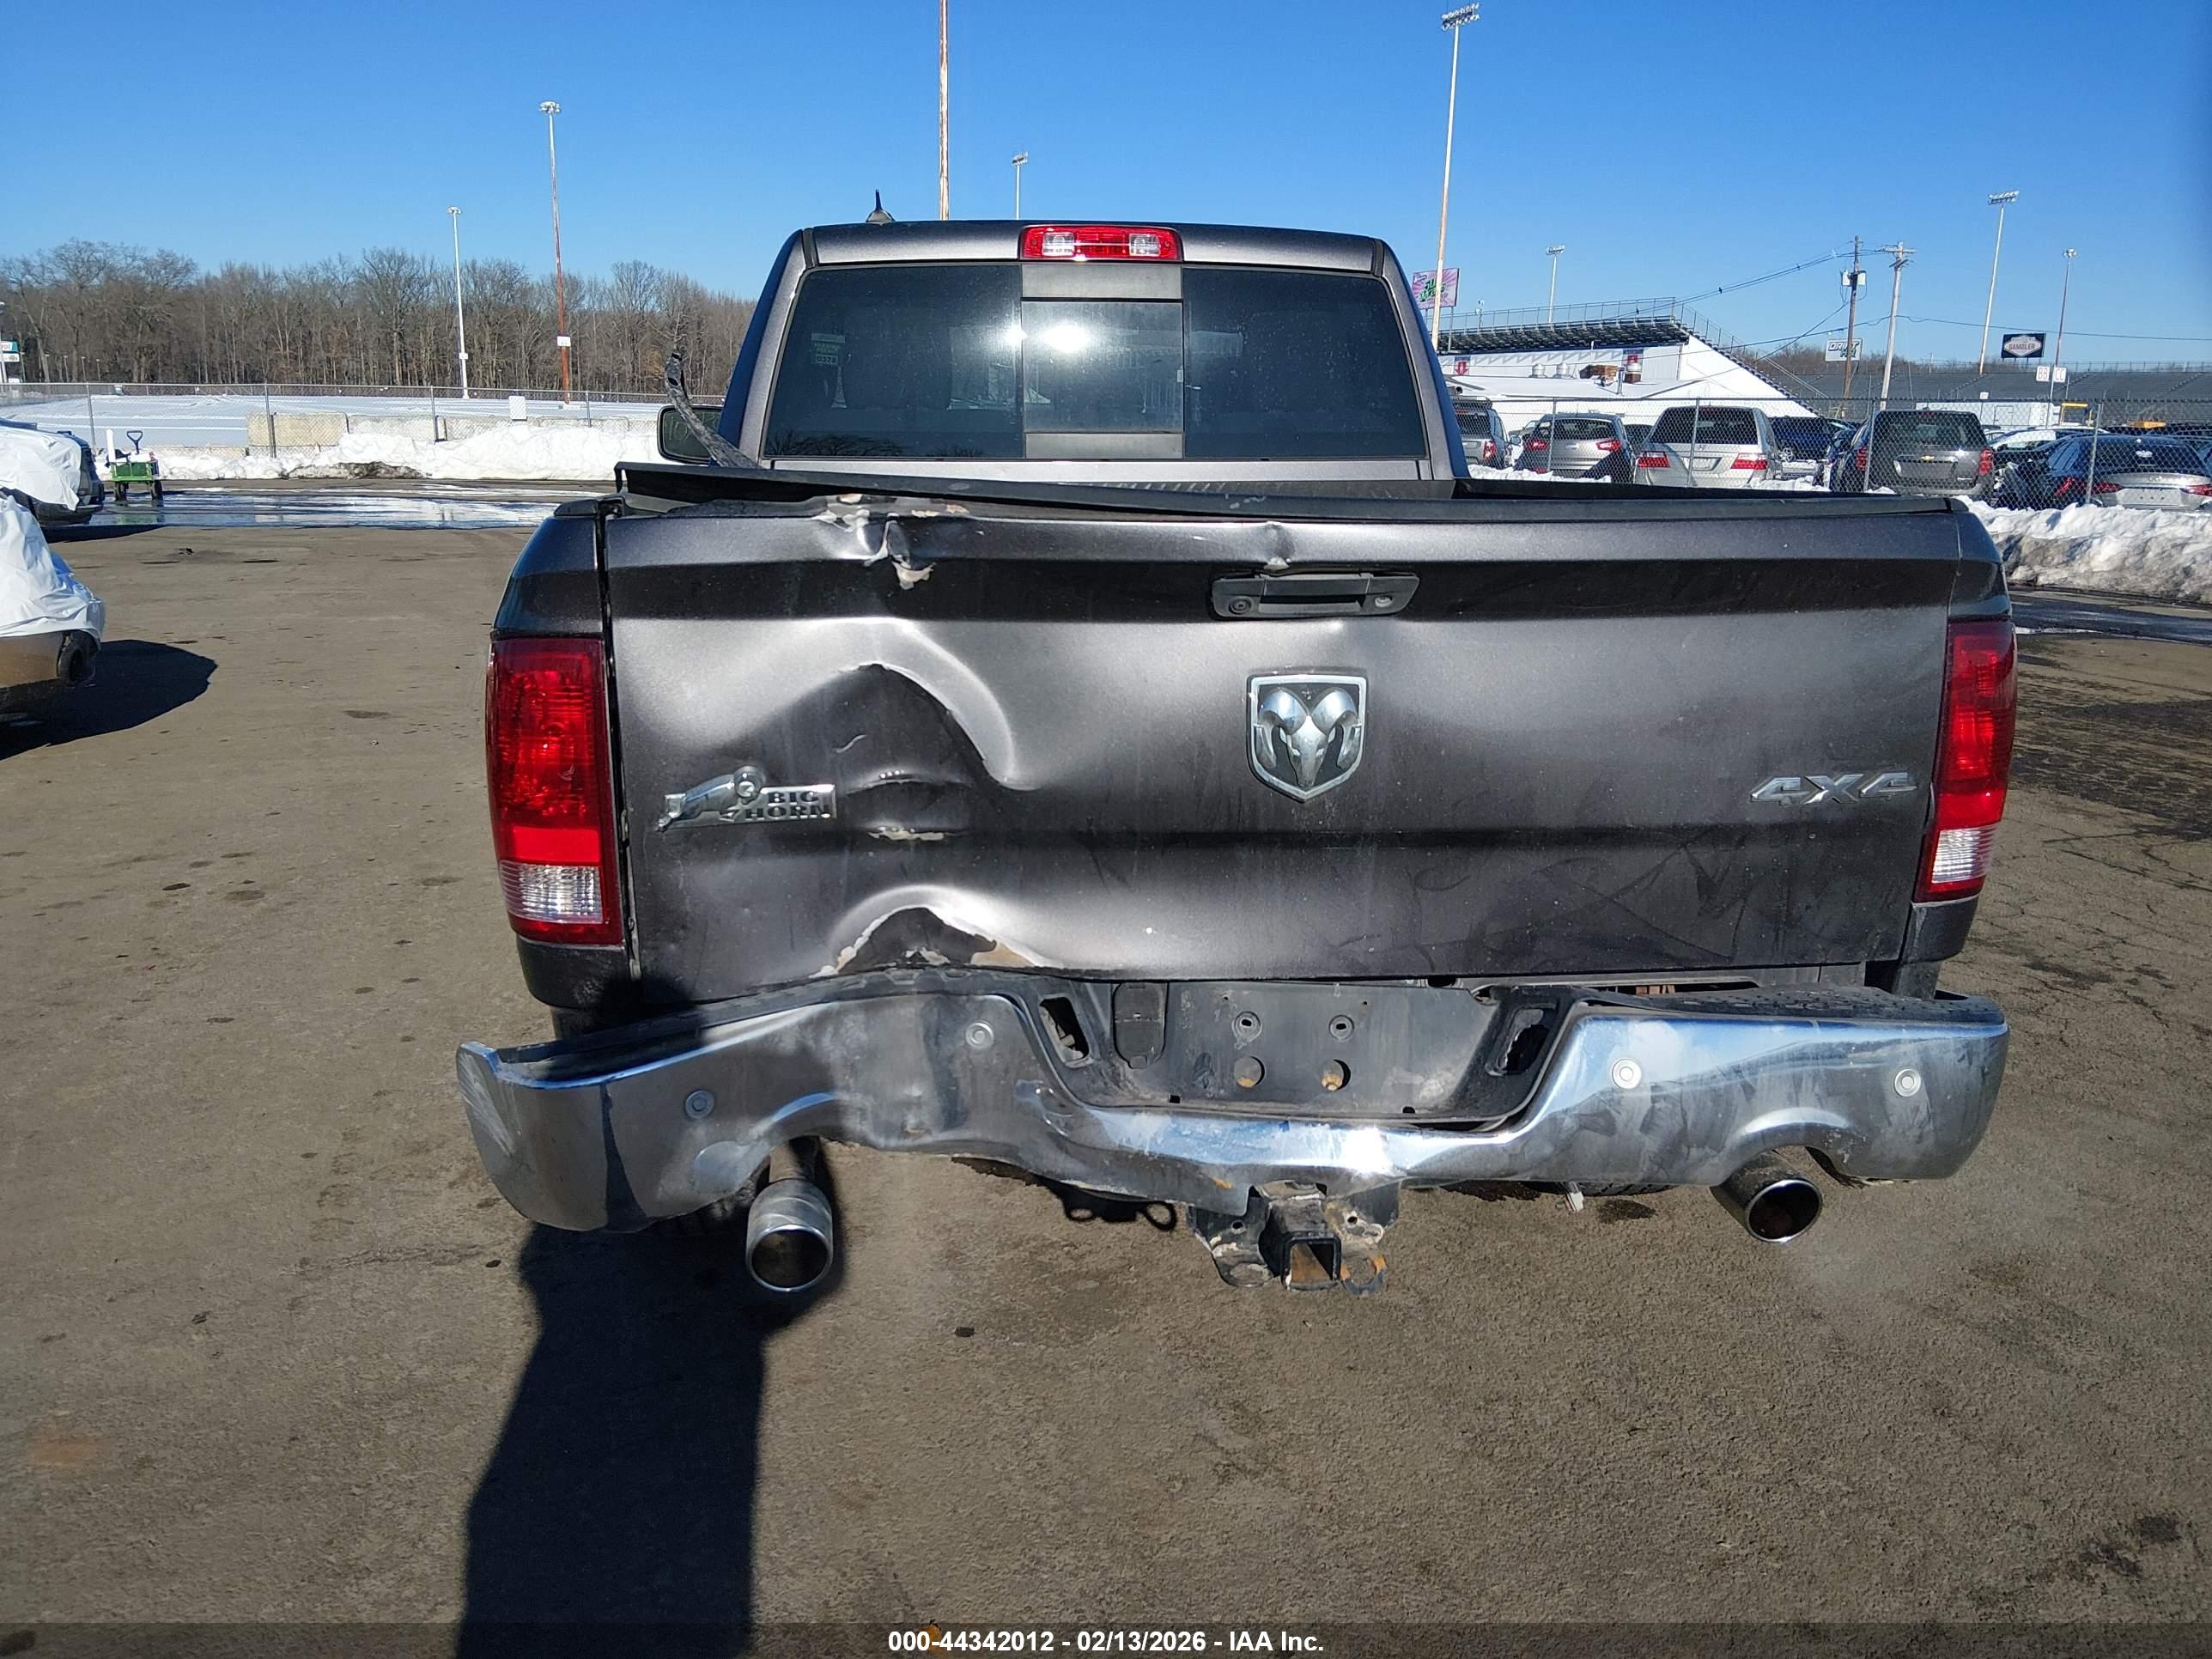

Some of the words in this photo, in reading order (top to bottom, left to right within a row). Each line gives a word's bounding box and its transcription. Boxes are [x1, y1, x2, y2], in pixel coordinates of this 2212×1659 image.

[1828, 341, 1860, 352] DRIT
[2038, 367, 2049, 380] BB
[2055, 368, 2065, 381] CC
[767, 791, 818, 804] BIG
[744, 805, 831, 820] HORN
